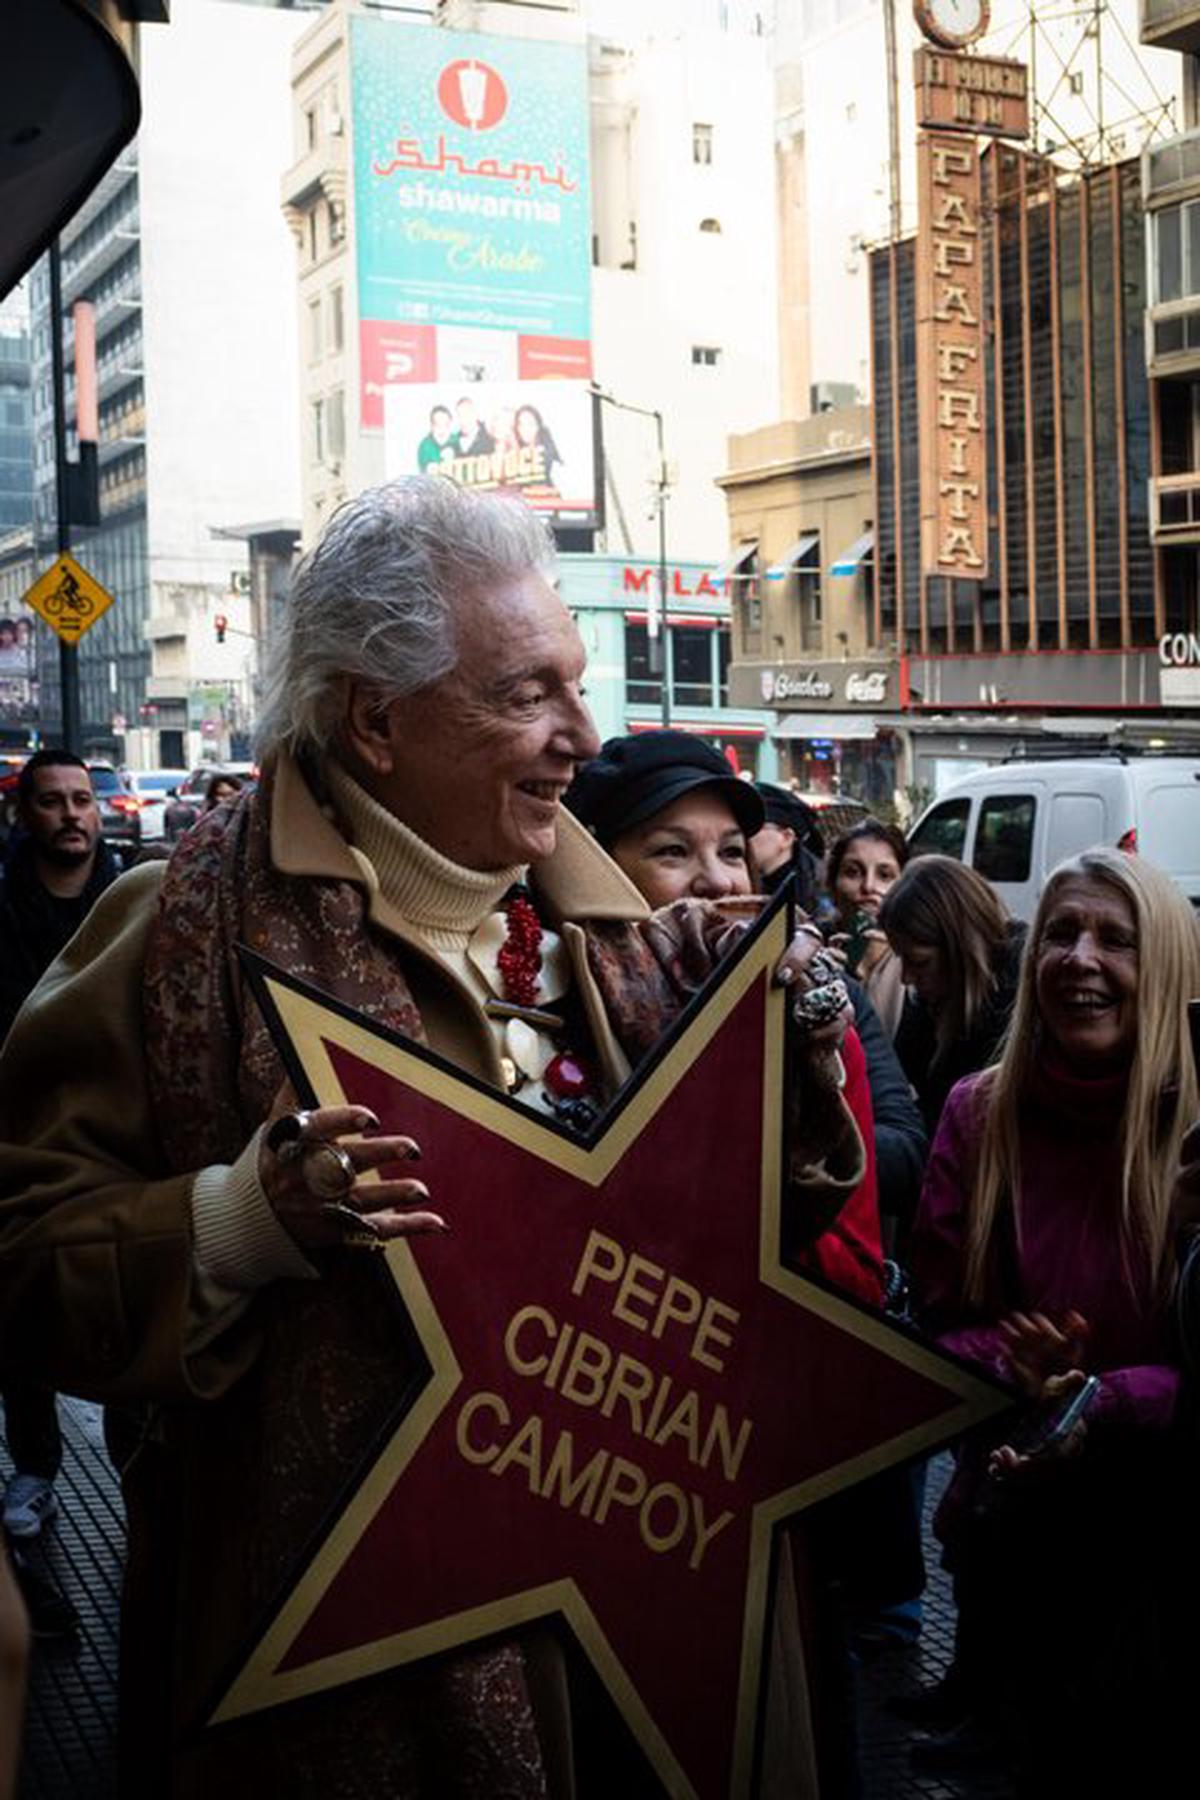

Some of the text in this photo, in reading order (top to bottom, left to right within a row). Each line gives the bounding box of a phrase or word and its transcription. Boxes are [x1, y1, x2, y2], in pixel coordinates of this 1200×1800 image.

[399, 182, 561, 223] shawarma
[931, 148, 979, 327] PAPA
[938, 342, 985, 568] FRITA
[570, 1229, 742, 1374] PEPE
[456, 1391, 736, 1571] CAMPOY
[504, 1304, 754, 1483] CIBRIAN
